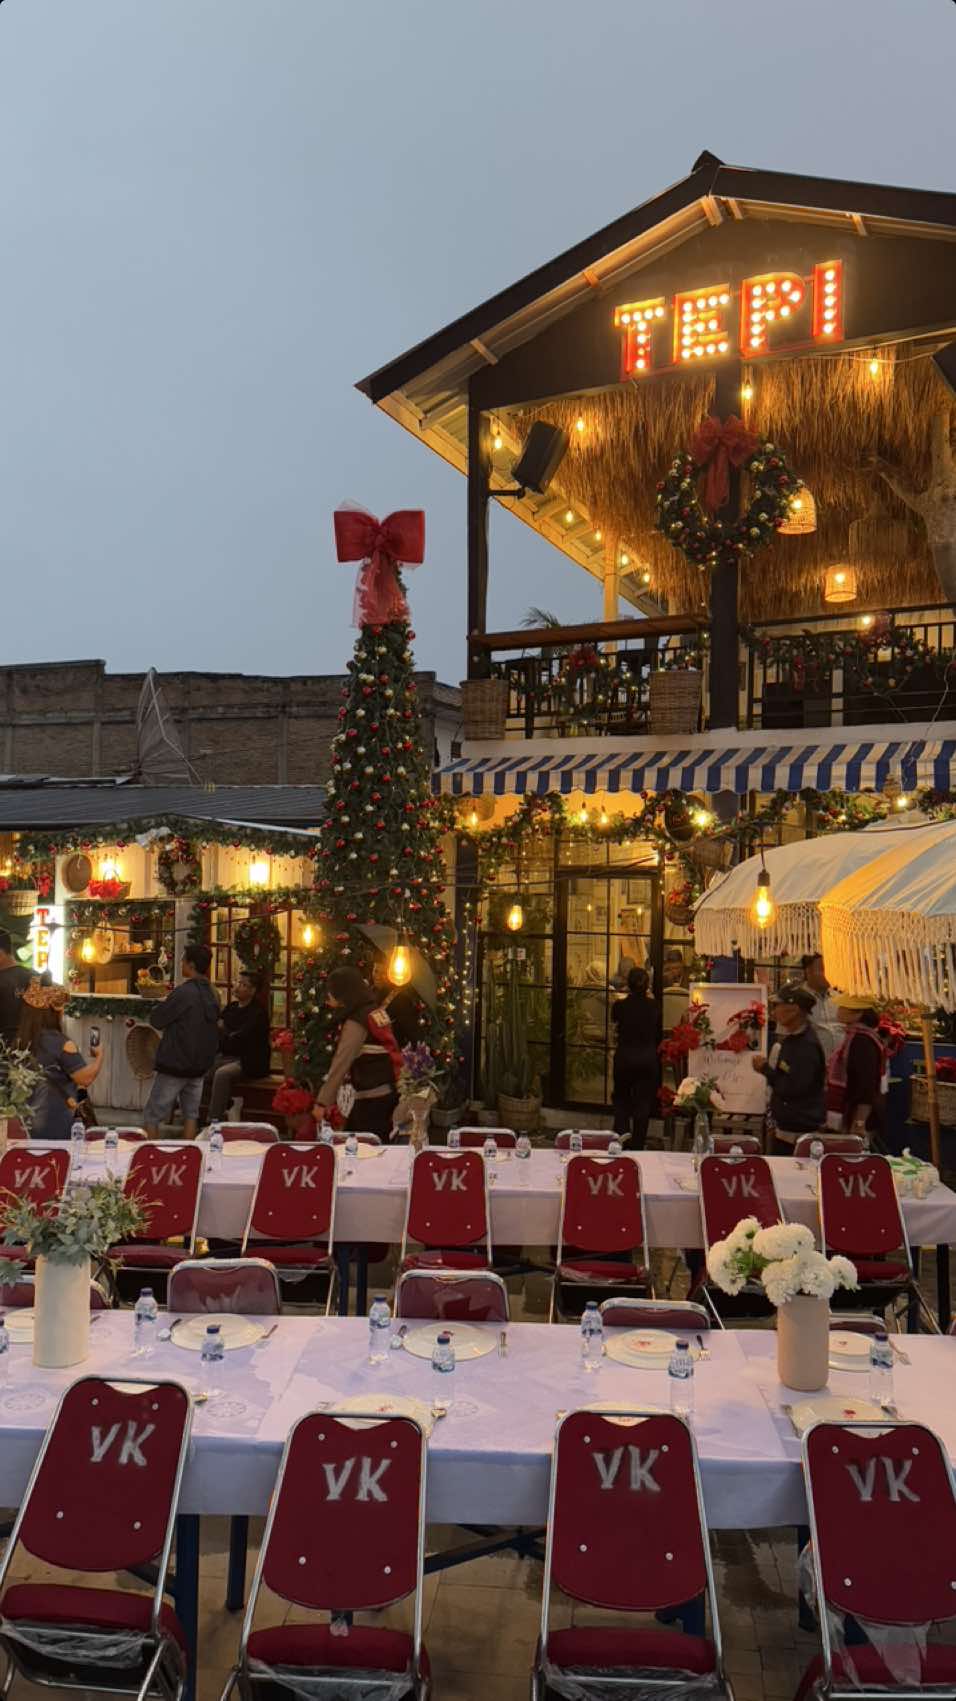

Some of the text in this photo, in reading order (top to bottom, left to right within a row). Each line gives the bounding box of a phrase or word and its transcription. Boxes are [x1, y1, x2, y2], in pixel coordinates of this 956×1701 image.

[614, 259, 844, 381] TEPI
[13, 1165, 49, 1189] VK
[151, 1163, 187, 1187] VK
[281, 1165, 319, 1189] VK
[432, 1168, 467, 1192] VK
[587, 1172, 624, 1197] VK
[721, 1173, 760, 1198] VK
[838, 1174, 877, 1199] VK
[90, 1420, 155, 1467] VK
[322, 1456, 391, 1502] VK
[593, 1444, 661, 1493] VK
[847, 1456, 921, 1502] VK
